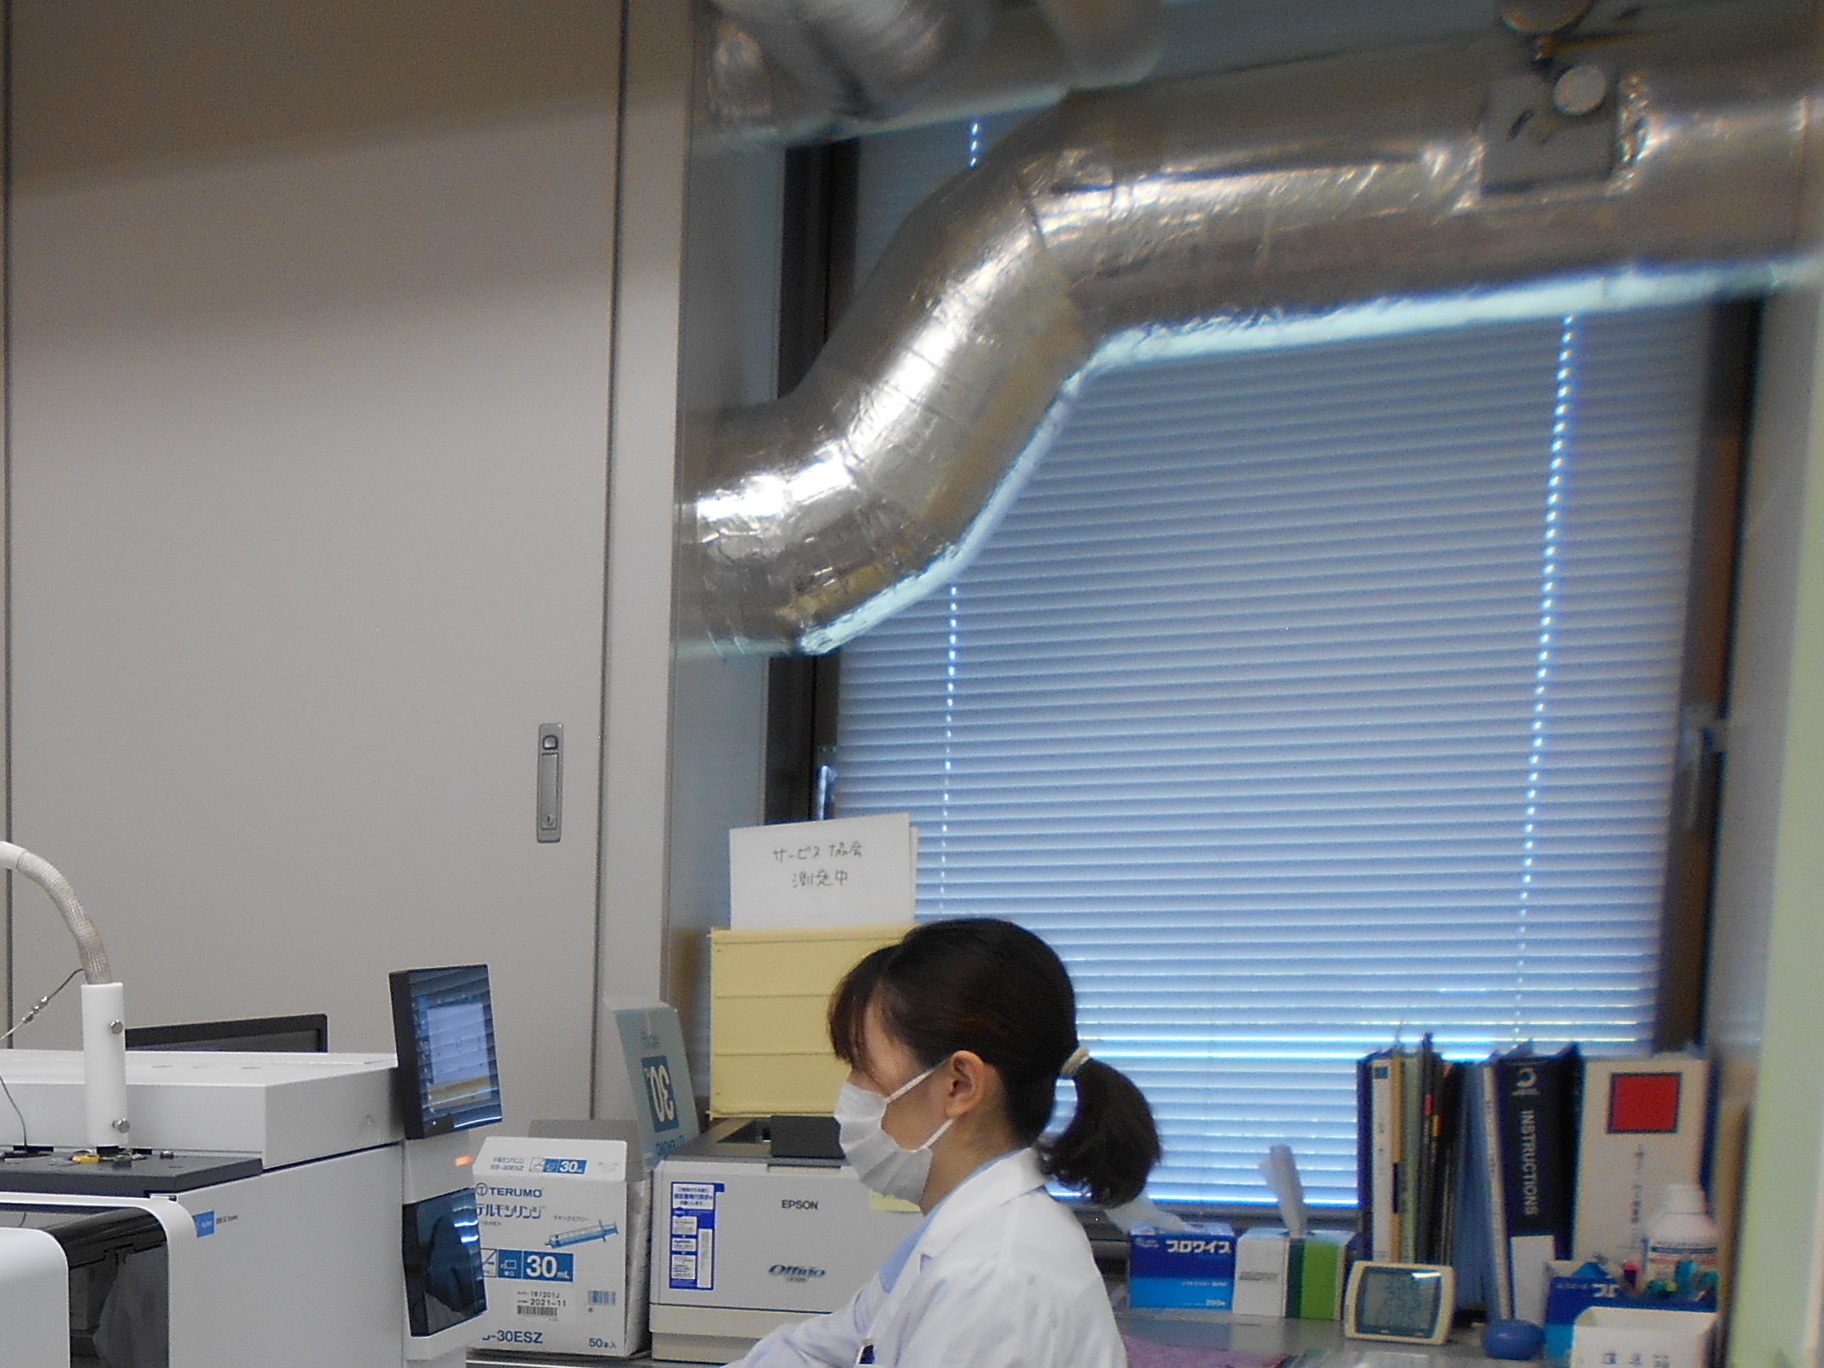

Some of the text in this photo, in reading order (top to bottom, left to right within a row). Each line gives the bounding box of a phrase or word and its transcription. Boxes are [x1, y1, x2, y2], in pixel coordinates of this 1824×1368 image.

[1521, 1109, 1539, 1216] INSTRUCTIONS
[489, 1186, 543, 1199] TERUMO
[781, 1199, 819, 1210] EPSON
[530, 1298, 566, 1307] 2021-11
